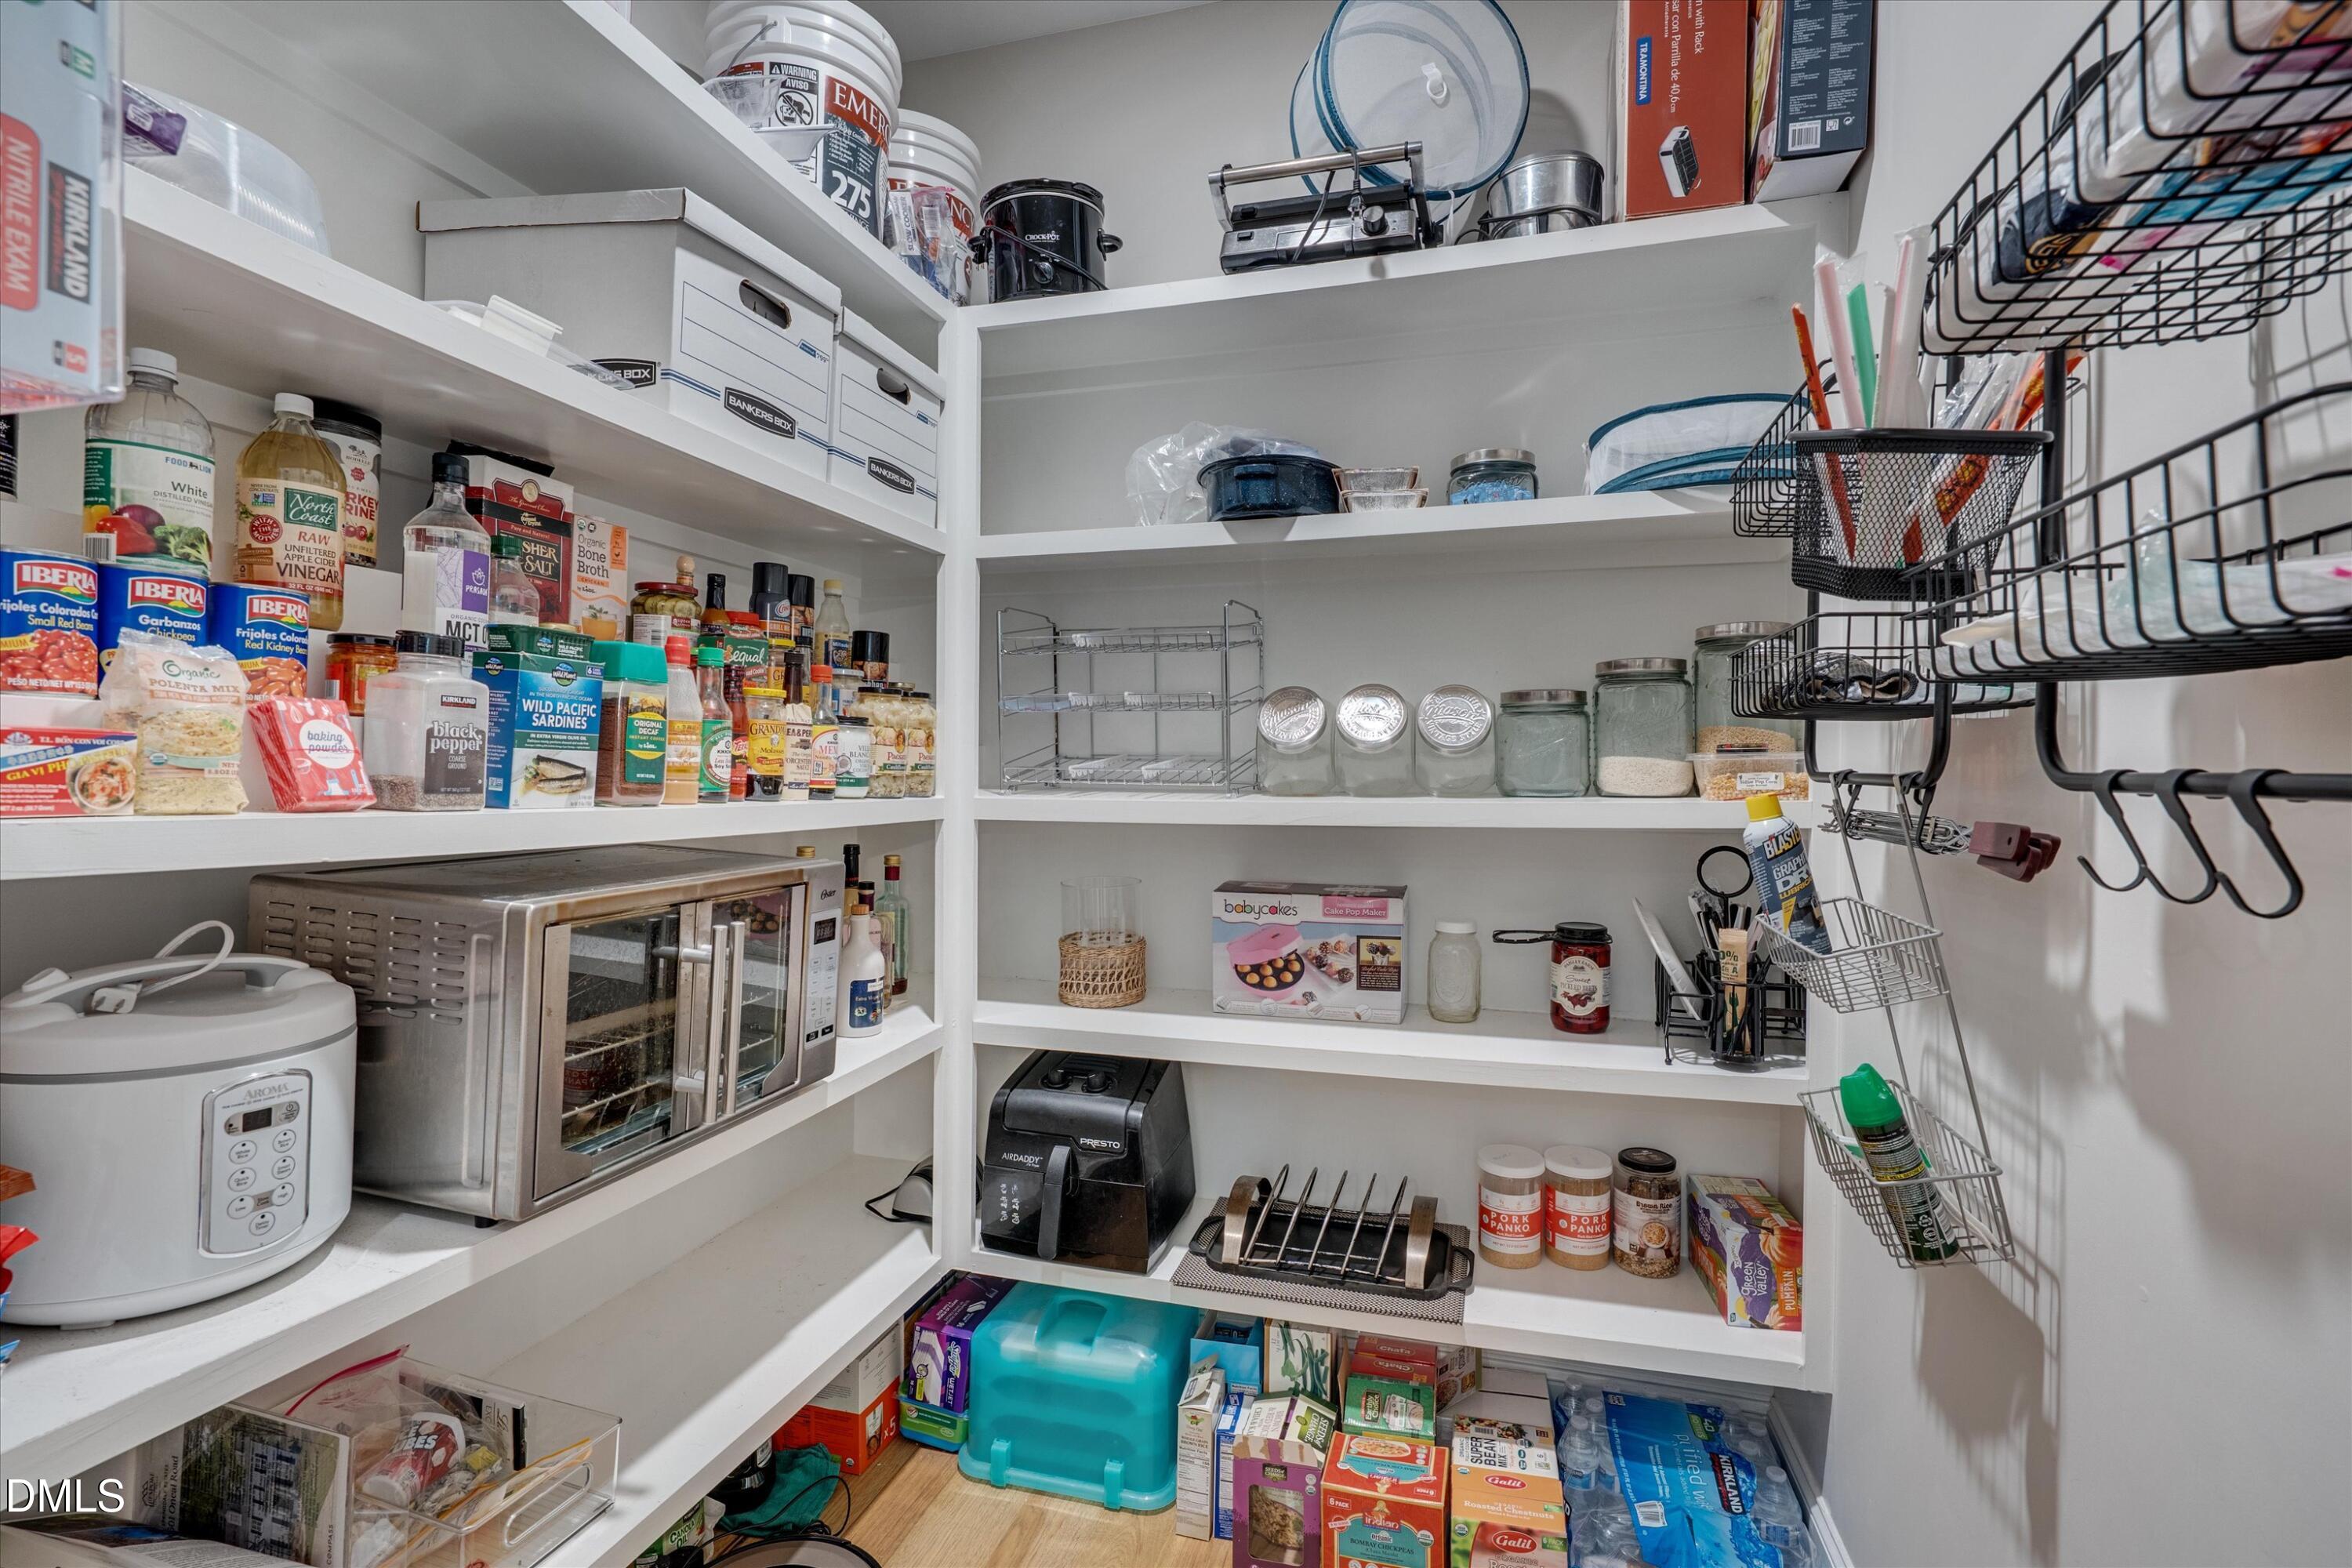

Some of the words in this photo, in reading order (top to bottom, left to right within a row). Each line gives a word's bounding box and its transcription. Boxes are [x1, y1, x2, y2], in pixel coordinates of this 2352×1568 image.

[1695, 9, 1705, 29] with
[1671, 34, 1682, 67] Parrilla
[1694, 31, 1704, 55] Rack
[780, 63, 817, 82] WARNING
[1639, 42, 1649, 100] TRAMONTINA
[1671, 69, 1680, 82] de
[786, 78, 809, 91] AVISO
[6, 136, 33, 228] NITRILE
[830, 170, 872, 220] 275
[902, 196, 912, 230] COOKER
[64, 176, 89, 298] KIRKLAND
[906, 230, 915, 252] SLOW
[6, 229, 31, 293] EXAM
[623, 368, 652, 379] BOX
[728, 394, 775, 423] BANKERS
[772, 416, 793, 433] BOX
[165, 456, 188, 468] FOOD
[198, 464, 212, 474] LION
[870, 462, 901, 486] BANKERS
[898, 478, 913, 490] BOX
[153, 490, 193, 503] DISTILLED
[170, 481, 209, 499] White
[289, 492, 336, 515] North
[252, 517, 274, 528] WITH
[289, 508, 334, 526] Coast
[252, 527, 281, 543] MOTHER
[297, 531, 331, 546] RAW
[510, 524, 522, 532] Pure
[532, 530, 550, 539] Natural
[285, 543, 337, 559] UNFILTERED
[577, 534, 607, 550] Organic
[284, 553, 314, 564] APPLE
[314, 556, 337, 568] CIDER
[576, 545, 608, 564] Bone
[276, 561, 340, 585] VINEGAR
[524, 554, 555, 576] SALT
[576, 559, 610, 579] Broth
[21, 564, 96, 593] IBERIA
[580, 577, 605, 587] CHICKEN
[134, 581, 205, 606] IBERIA
[39, 602, 91, 619] Colorados
[252, 598, 309, 621] IBERIA
[450, 613, 477, 623] ORGANIC
[27, 614, 56, 628] Small
[57, 618, 74, 629] Red
[137, 614, 201, 631] Garbanzos
[147, 627, 196, 642] Chickpeas
[235, 627, 278, 642] Frijoles
[445, 619, 481, 644] MCT
[244, 639, 264, 650] Red
[265, 642, 295, 655] Kidney
[731, 648, 765, 667] equal
[162, 659, 221, 681] Organic
[147, 677, 209, 694] POLENTA
[212, 683, 241, 695] MIX
[442, 695, 476, 705] KIRKLAND
[522, 698, 554, 714] WILD
[556, 703, 597, 718] PACIFIC
[532, 713, 588, 730] SARDINES
[633, 719, 663, 729] ORIGINAL
[307, 730, 346, 745] baking
[429, 736, 484, 754] pepper
[307, 742, 352, 754] powder
[5, 769, 31, 782] GIA
[820, 888, 837, 901] Oster
[1224, 899, 1298, 920] babycakes
[1345, 909, 1361, 917] Pop
[1565, 975, 1591, 984] Sweet
[243, 1083, 289, 1101] AROMA
[1080, 1138, 1121, 1149] PRESTO
[1001, 1152, 1040, 1164] AIRDADDY
[1635, 1200, 1658, 1210] Brown
[1490, 1211, 1530, 1224] PORK
[1490, 1220, 1530, 1232] PANKO
[1570, 1213, 1607, 1225] PORK
[1570, 1222, 1608, 1233] PANKO
[1784, 1270, 1797, 1311] PUMPKIN
[948, 1341, 961, 1379] Swiffer
[946, 1377, 956, 1406] WETJET
[1365, 1392, 1375, 1421] Earthly
[1371, 1394, 1380, 1418] Choice
[1304, 1412, 1317, 1443] CHANGE
[1318, 1416, 1330, 1442] SEEDS
[1703, 1417, 1716, 1433] 40
[1470, 1436, 1484, 1465] SUPER
[1483, 1438, 1497, 1467] BEAN
[169, 1455, 180, 1481] Road
[1497, 1454, 1508, 1468] MIX
[1486, 1475, 1524, 1489] Galil
[1719, 1454, 1743, 1515] KIRKLAND
[168, 1484, 178, 1515] Oneal
[1463, 1500, 1503, 1512] Roasted
[1503, 1506, 1555, 1520] Chestnuts
[670, 1518, 696, 1544] CANOLA
[1371, 1534, 1392, 1543] Organic
[676, 1534, 688, 1549] OIL
[1350, 1537, 1377, 1548] BOMBAY
[1377, 1543, 1414, 1555] CHICKPEAS
[1495, 1534, 1533, 1551] Galil
[1494, 1554, 1540, 1566] ORGANIC
